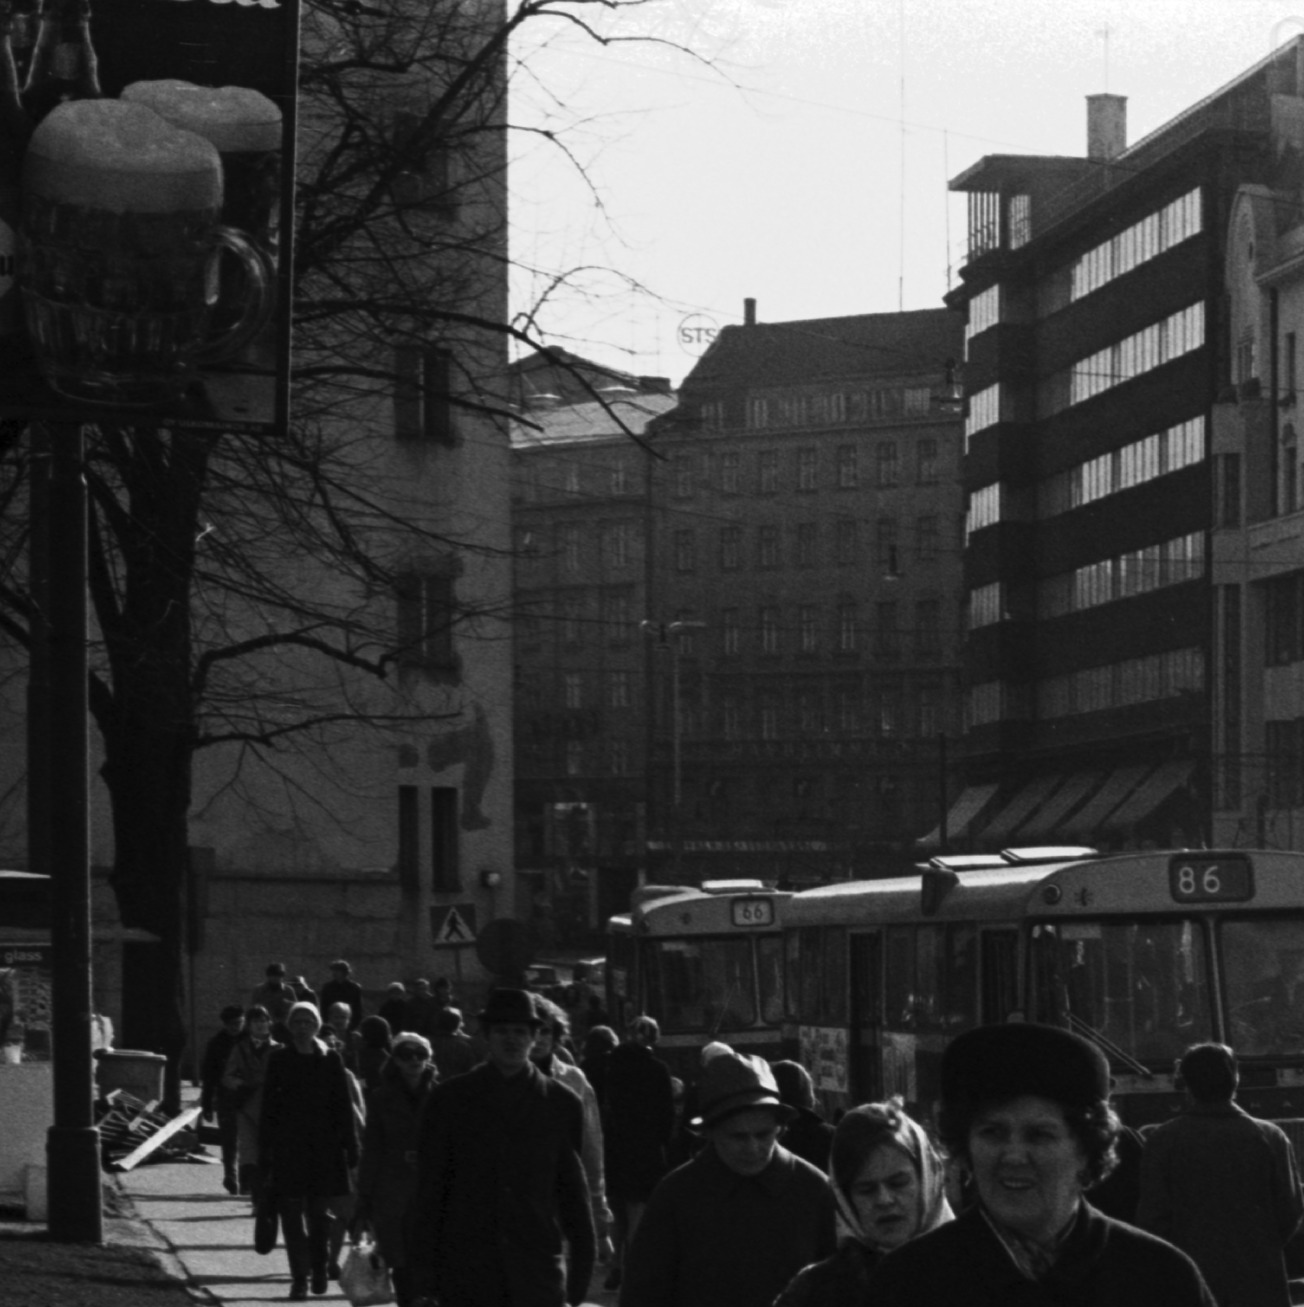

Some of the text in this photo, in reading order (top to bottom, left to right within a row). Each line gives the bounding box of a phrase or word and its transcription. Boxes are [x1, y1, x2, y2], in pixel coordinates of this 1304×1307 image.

[1178, 865, 1221, 895] 86
[743, 902, 763, 920] 66
[4, 949, 43, 964] glass
